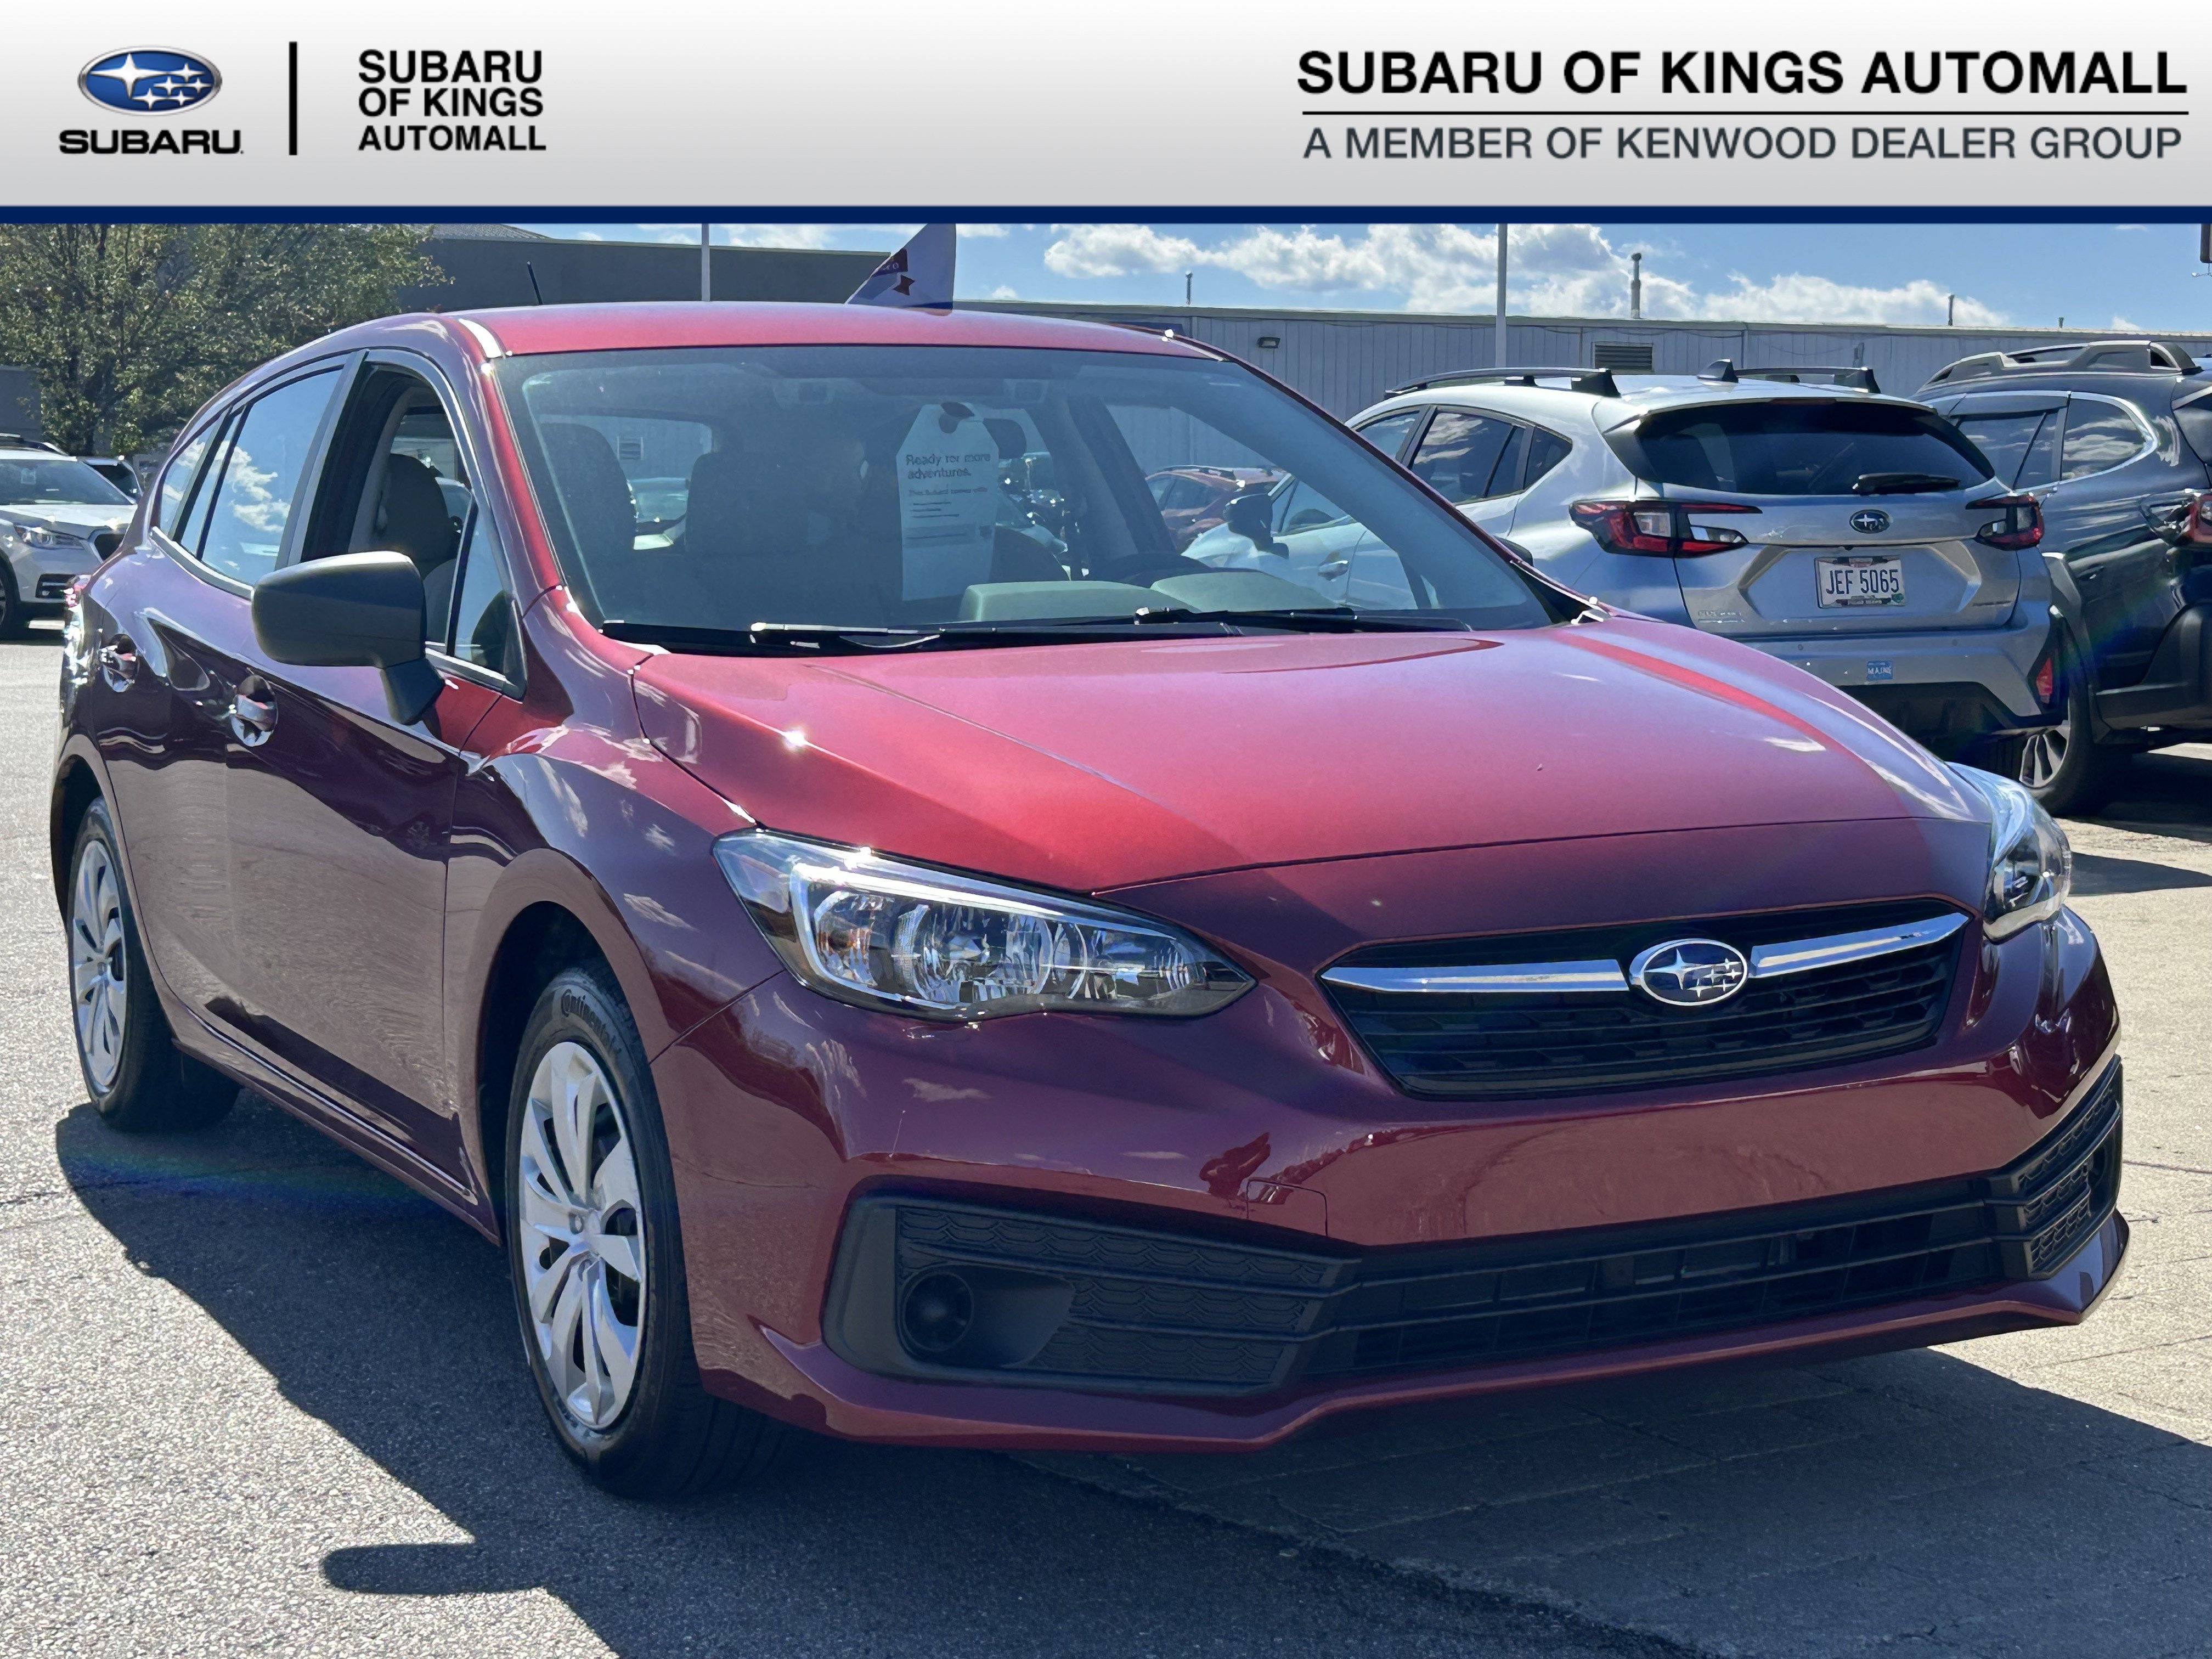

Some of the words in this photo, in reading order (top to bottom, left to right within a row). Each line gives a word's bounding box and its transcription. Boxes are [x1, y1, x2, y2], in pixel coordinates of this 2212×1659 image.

[906, 454, 941, 466] Ready
[1826, 569, 1854, 594] JEF
[1860, 569, 1899, 594] 5065
